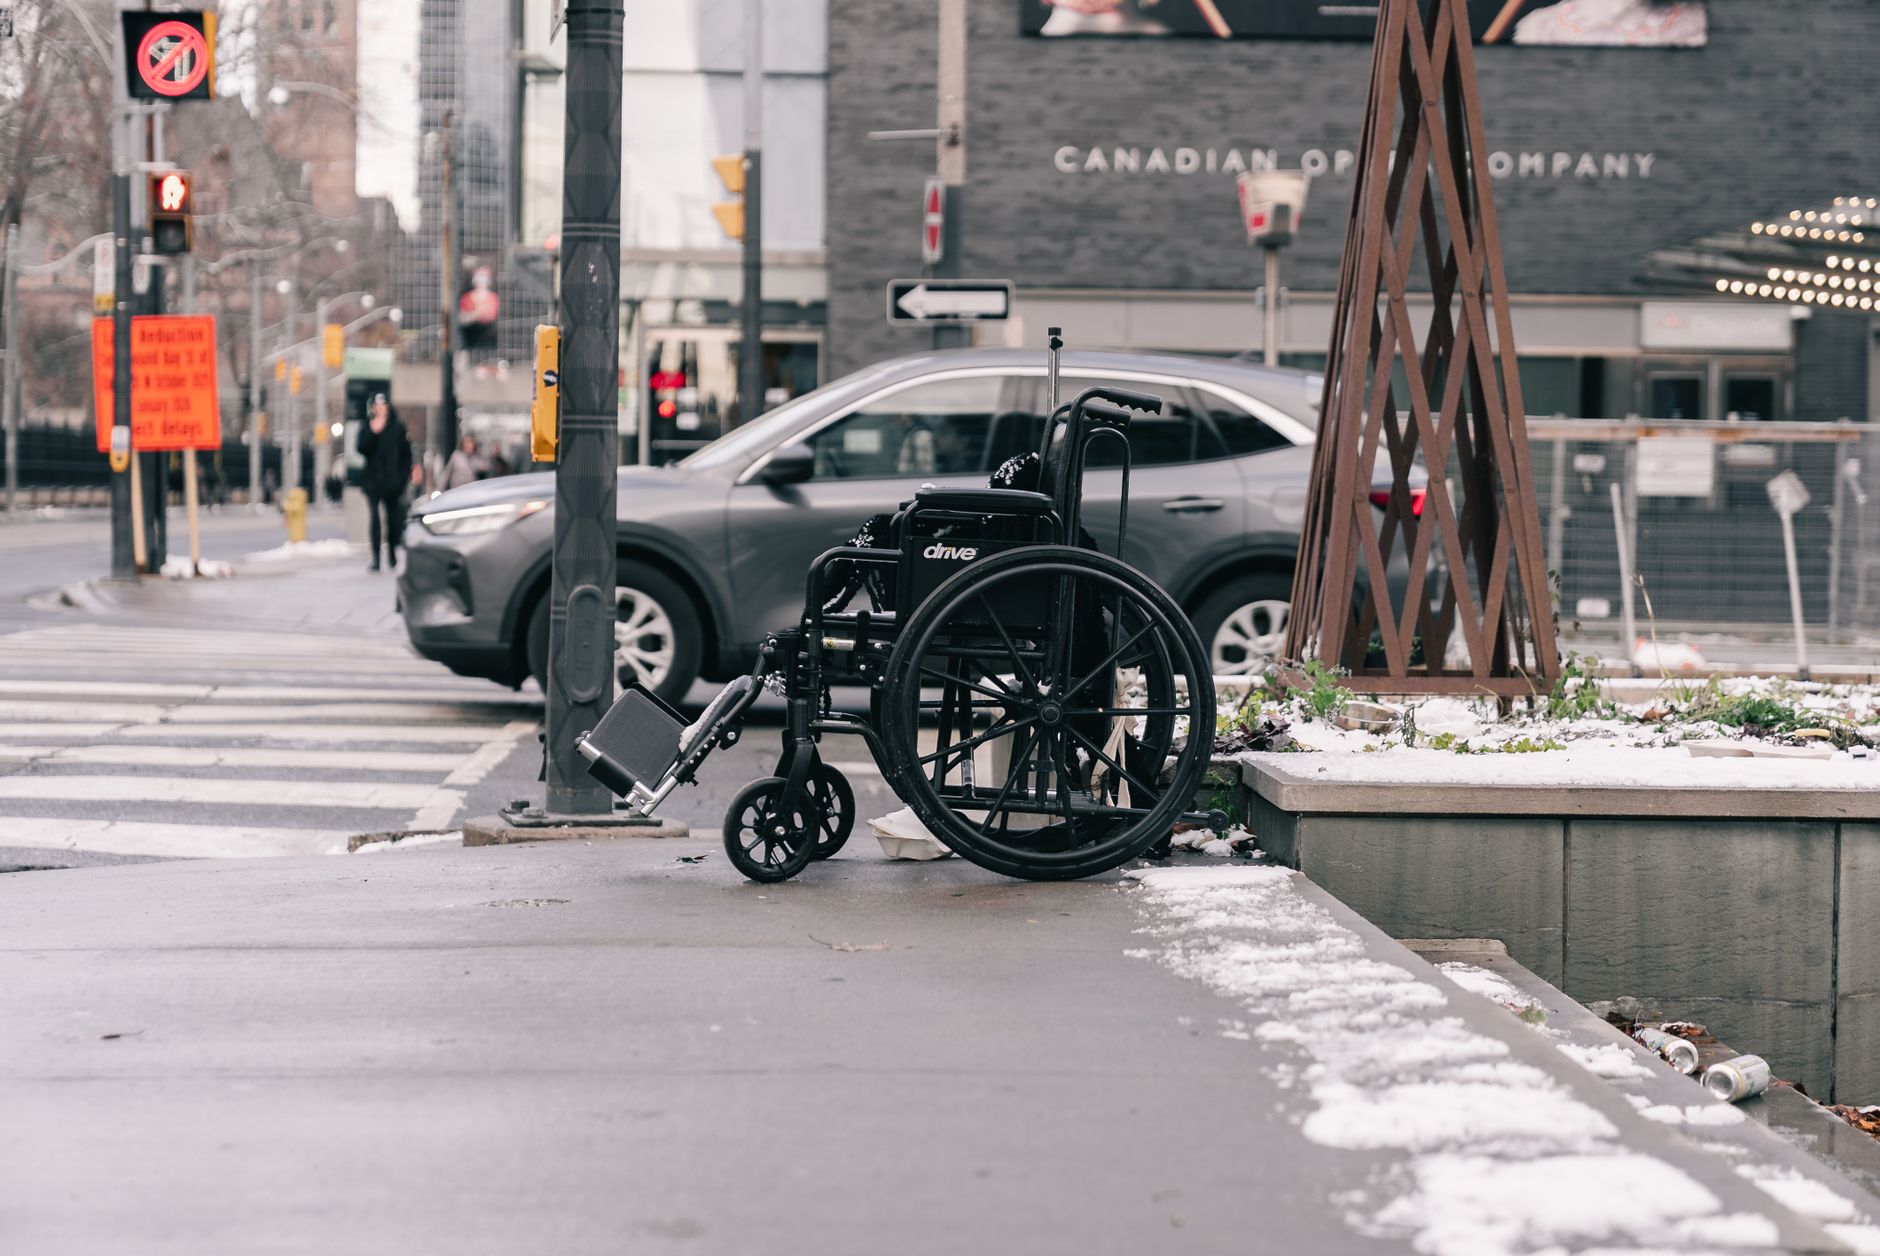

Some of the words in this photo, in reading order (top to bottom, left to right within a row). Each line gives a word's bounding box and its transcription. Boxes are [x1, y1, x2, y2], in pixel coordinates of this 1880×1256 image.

[1053, 145, 1278, 174] CANADIAN
[1466, 150, 1656, 178] OMPANY
[923, 543, 976, 560] drive
